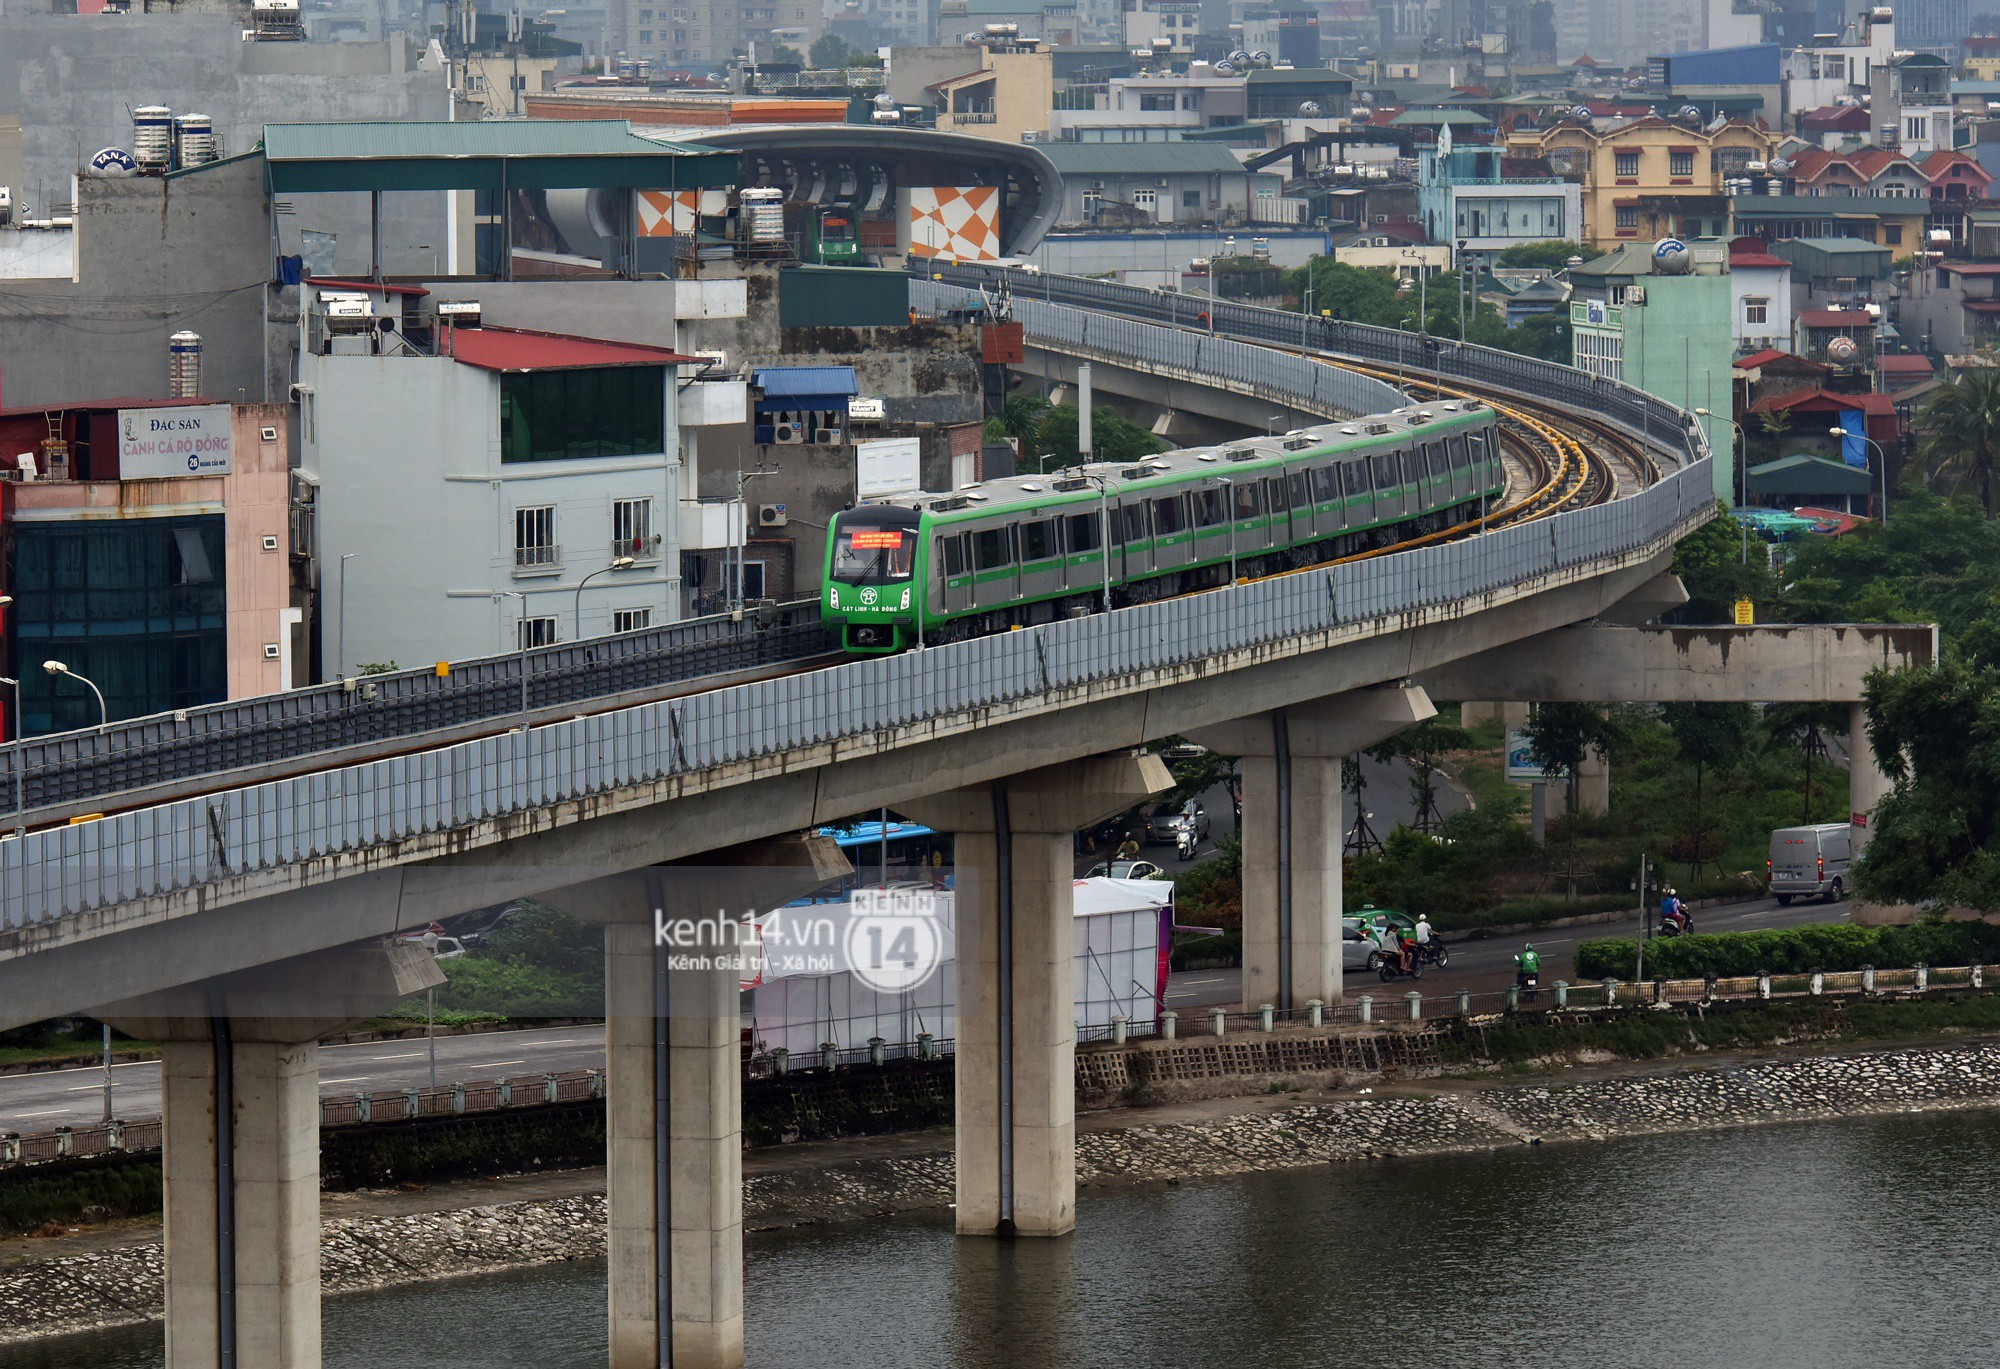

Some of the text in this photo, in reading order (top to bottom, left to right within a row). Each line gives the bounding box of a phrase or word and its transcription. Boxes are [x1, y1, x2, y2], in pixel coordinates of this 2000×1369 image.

[123, 441, 155, 456] CANH
[177, 437, 193, 453] RÔ
[189, 457, 198, 468] 26
